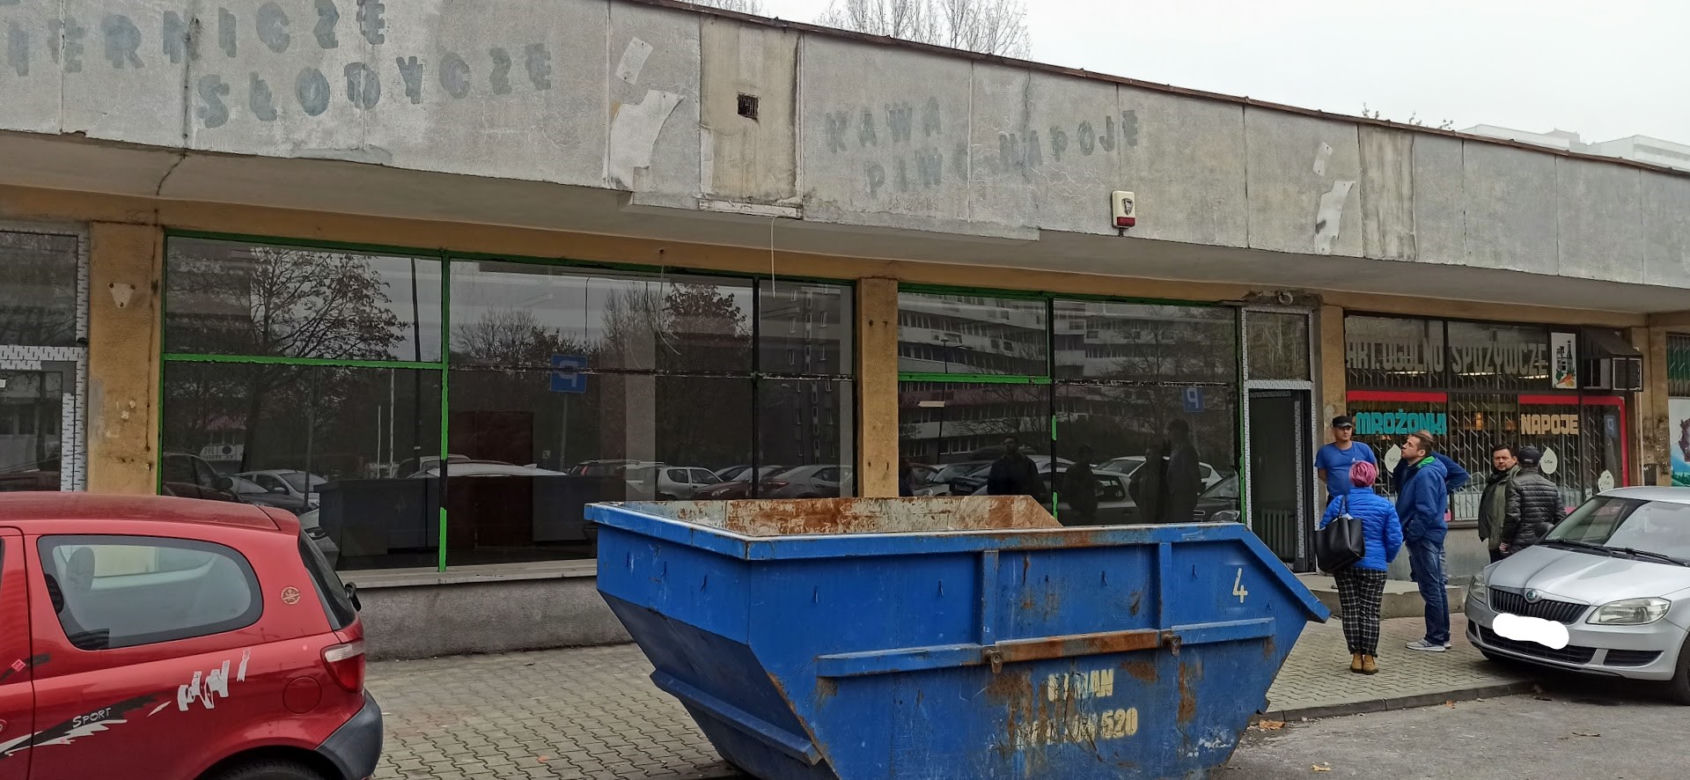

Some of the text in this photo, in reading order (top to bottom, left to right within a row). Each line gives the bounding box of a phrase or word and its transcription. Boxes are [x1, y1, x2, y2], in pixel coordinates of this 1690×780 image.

[824, 96, 943, 154] KAWA
[1355, 408, 1447, 435] MROŻONKI
[1520, 413, 1579, 435] NAPOJE
[1232, 567, 1249, 604] 4
[72, 707, 112, 729] SPORT
[1101, 707, 1138, 739] 520
